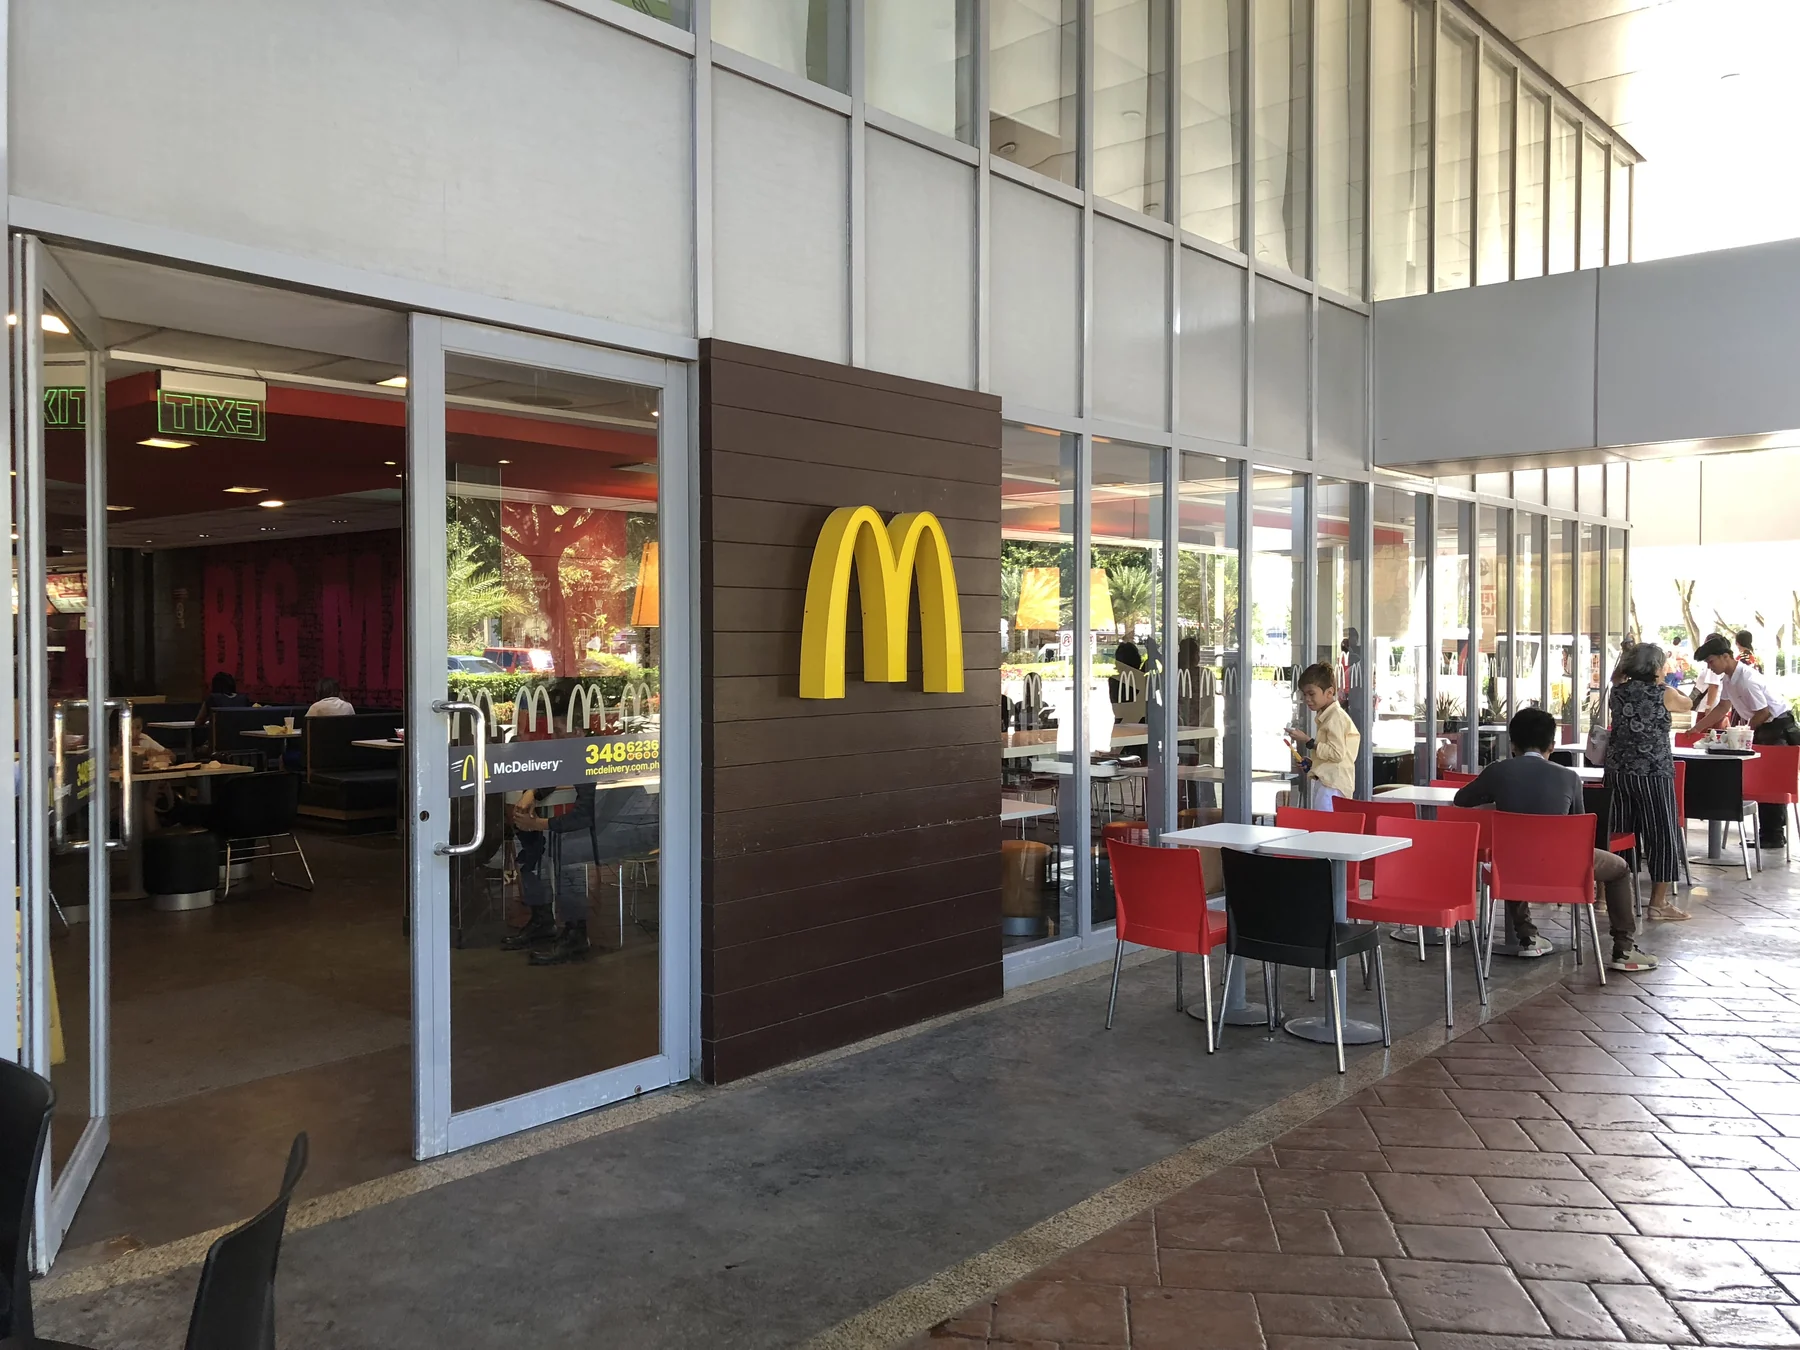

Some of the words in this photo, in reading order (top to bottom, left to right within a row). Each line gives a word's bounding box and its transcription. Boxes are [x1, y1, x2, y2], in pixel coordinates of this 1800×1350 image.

[585, 742, 627, 765] 348
[626, 740, 660, 753] 6236
[585, 760, 660, 776] mcdelivery.com.ph
